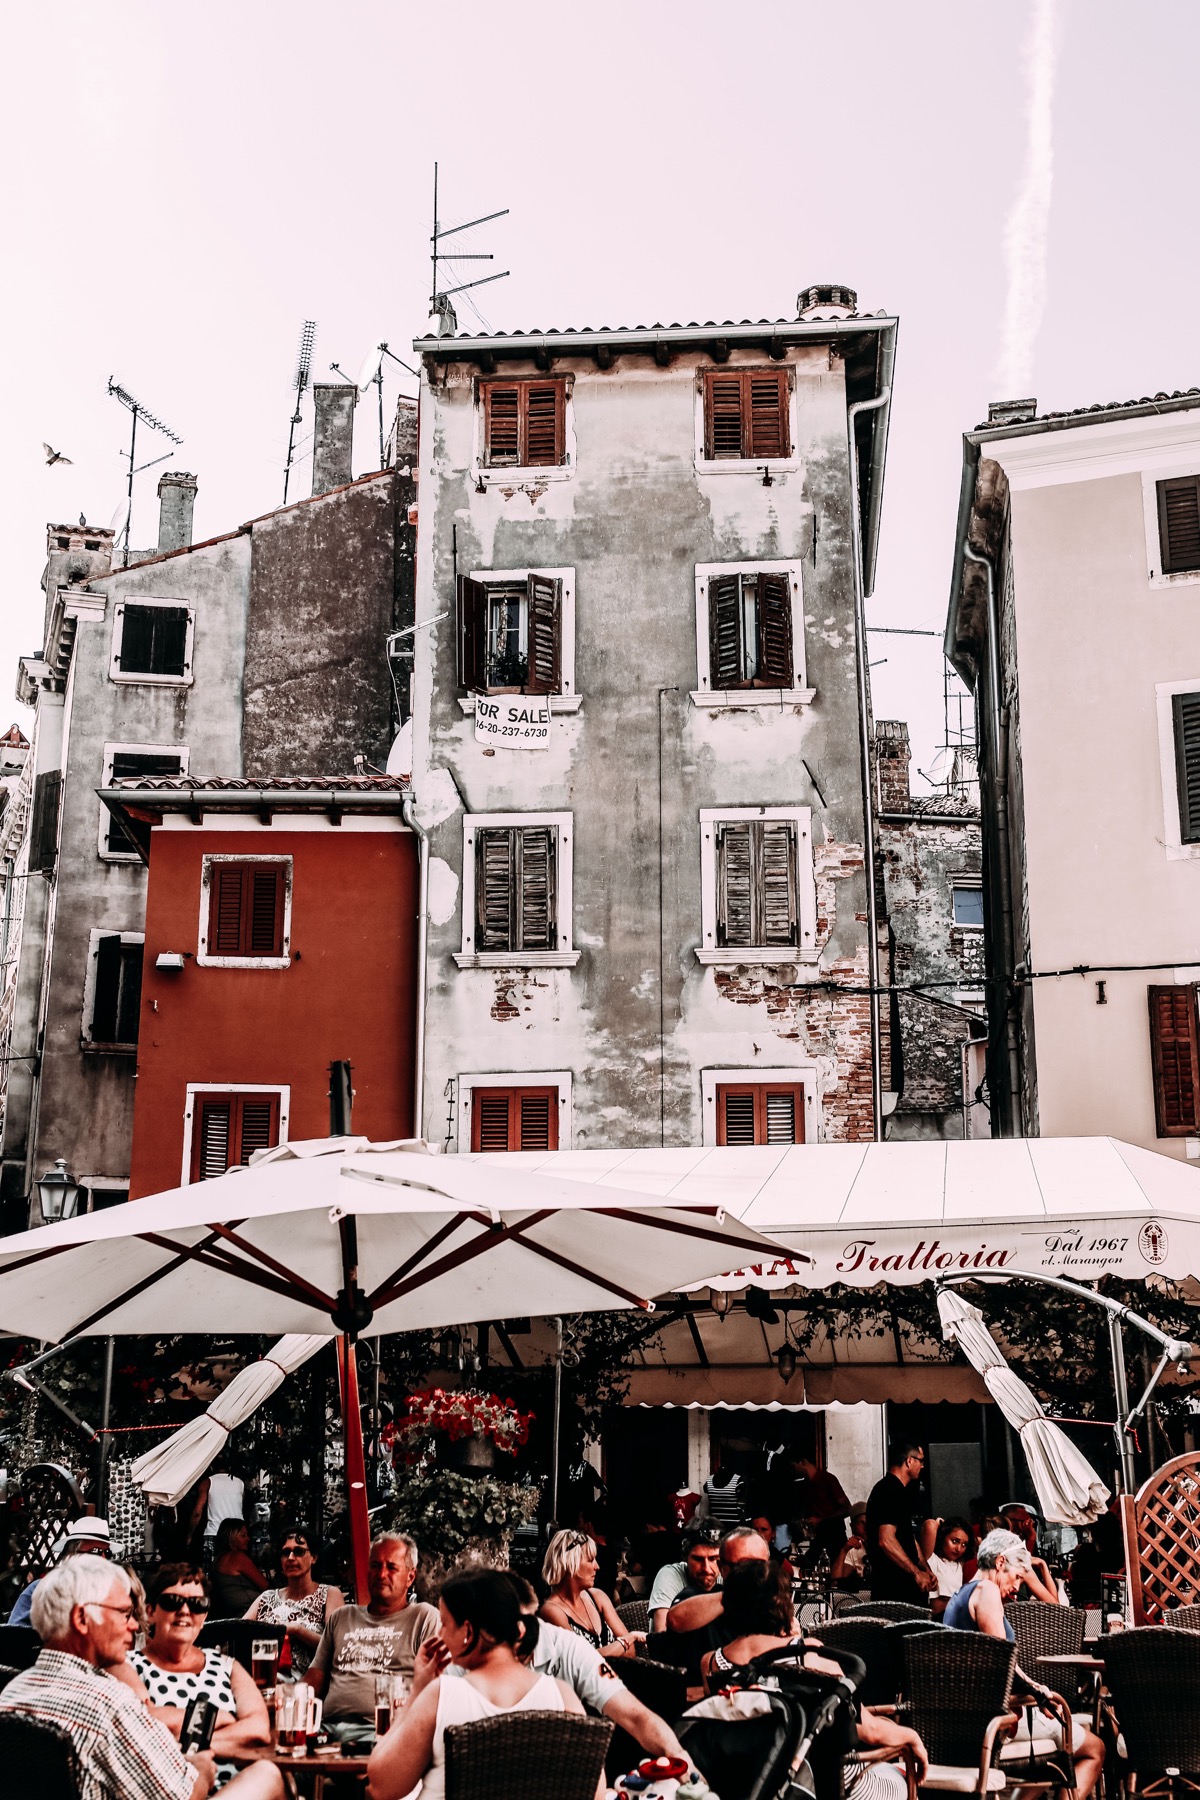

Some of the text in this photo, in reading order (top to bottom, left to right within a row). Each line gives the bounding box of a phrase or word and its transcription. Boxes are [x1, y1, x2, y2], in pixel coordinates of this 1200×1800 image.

[507, 707, 548, 724] SALE
[1045, 1235, 1130, 1252] Dal 1967
[835, 1240, 1018, 1273] Trattoria
[1057, 1253, 1123, 1269] Marangon
